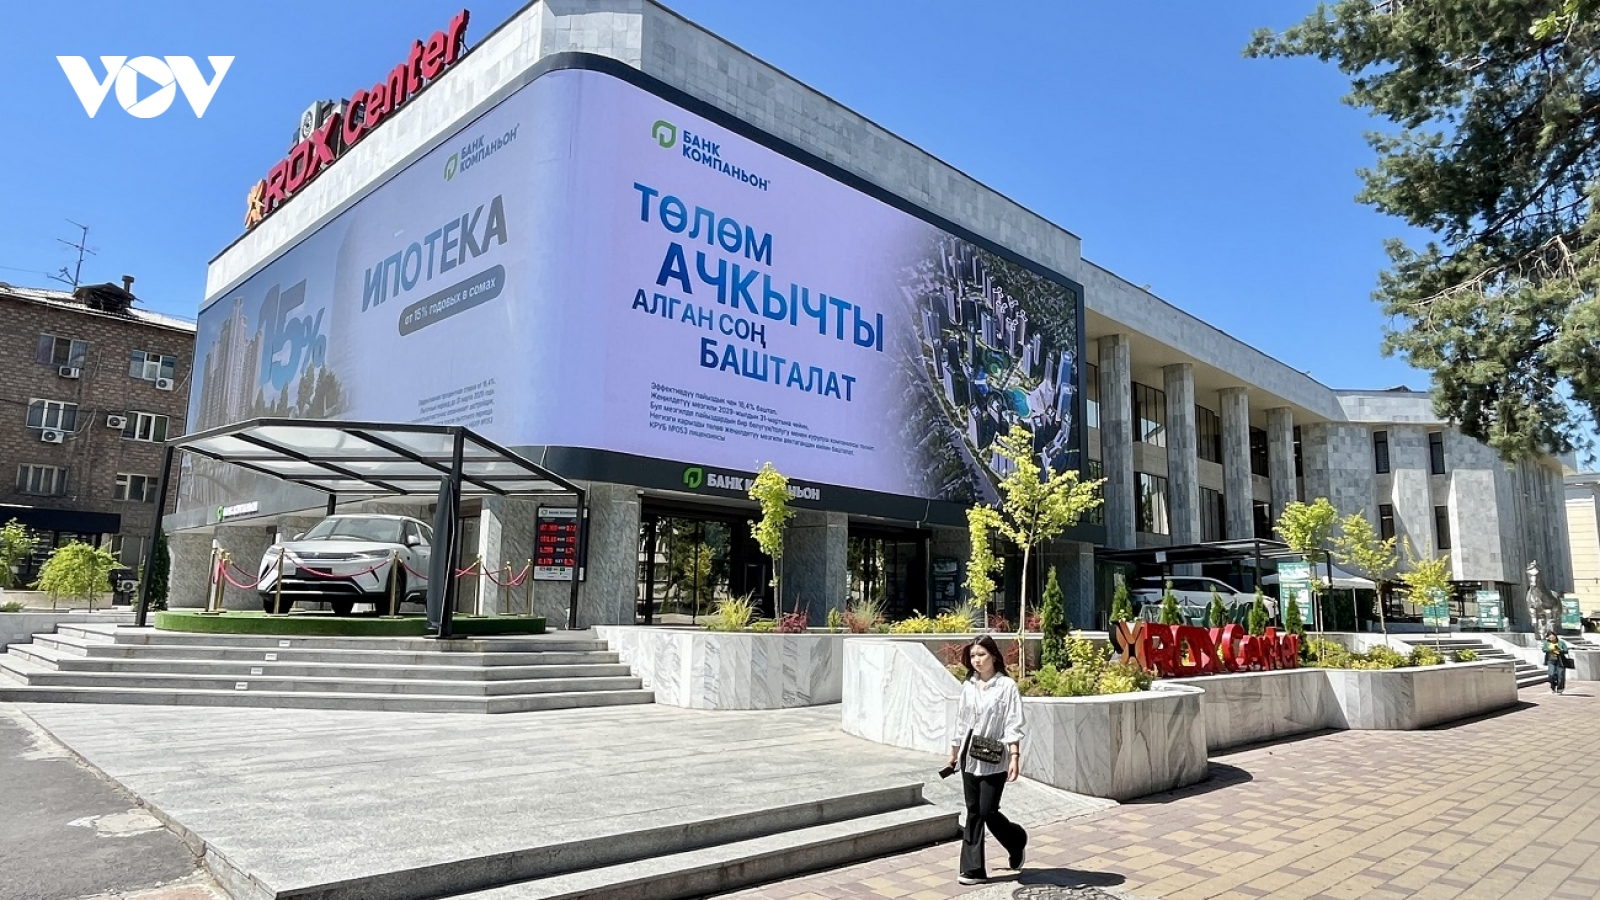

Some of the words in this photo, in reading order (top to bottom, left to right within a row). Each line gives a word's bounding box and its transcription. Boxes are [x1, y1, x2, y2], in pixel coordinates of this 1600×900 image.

[263, 113, 340, 213] ROX
[342, 9, 470, 145] Center
[460, 126, 518, 172] КОМПАНЬОН
[461, 134, 485, 160] БАНК
[682, 144, 768, 191] КОМПАНЬОН
[683, 130, 720, 157] БАНК
[361, 194, 508, 313] ИПОТЕКА
[633, 182, 772, 266] ТӨЛӨМ
[404, 313, 413, 325] от
[414, 304, 428, 321] 15%
[429, 292, 461, 314] годовых
[462, 290, 468, 300] в
[469, 277, 496, 298] сомах
[632, 288, 713, 331] АЛГАН
[719, 313, 767, 349] СОҢ
[656, 242, 883, 352] АЧКЫЧТЫ
[258, 278, 327, 390] 15%
[700, 337, 856, 401] БАШТАЛАТ
[707, 473, 744, 491] БАНК
